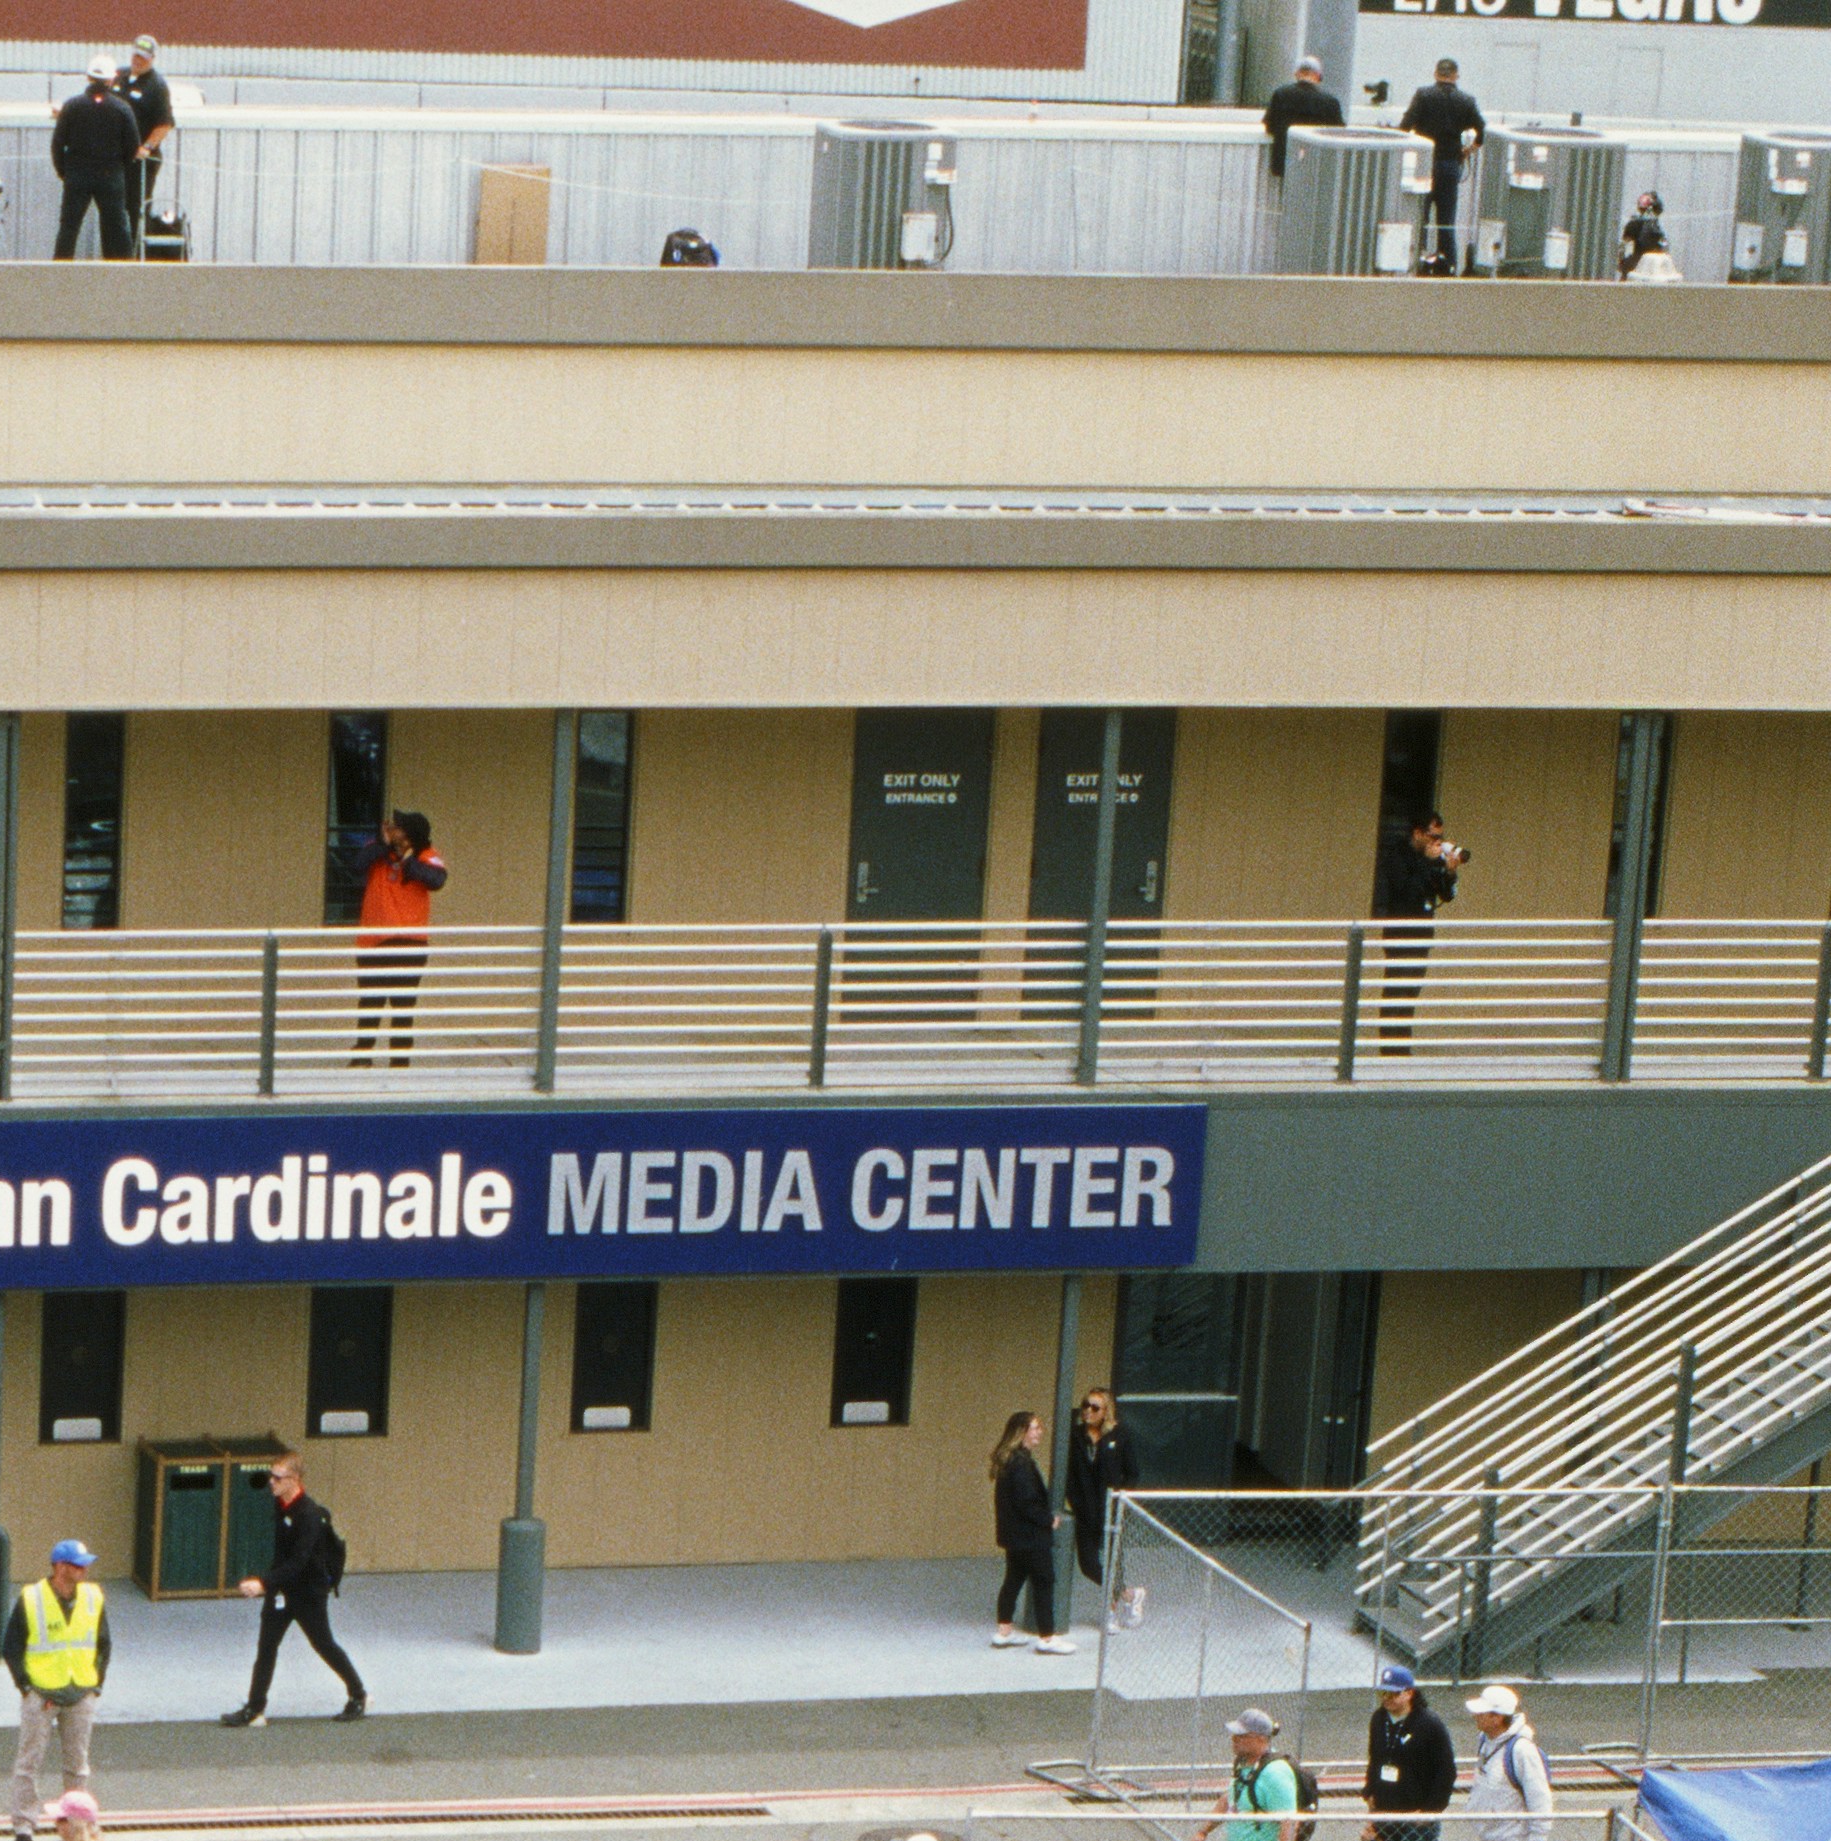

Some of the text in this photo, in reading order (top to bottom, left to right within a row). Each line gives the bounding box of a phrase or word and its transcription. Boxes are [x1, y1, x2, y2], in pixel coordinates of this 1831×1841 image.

[883, 774, 961, 787] EXIT ONLY
[1066, 774, 1099, 787] EXIT
[884, 793, 946, 804] ENTRANCE
[1067, 793, 1128, 804] ENTRCE
[101, 1153, 513, 1246] Cardinale
[547, 1149, 823, 1236] MEDIA
[849, 1146, 1177, 1233] CENTER
